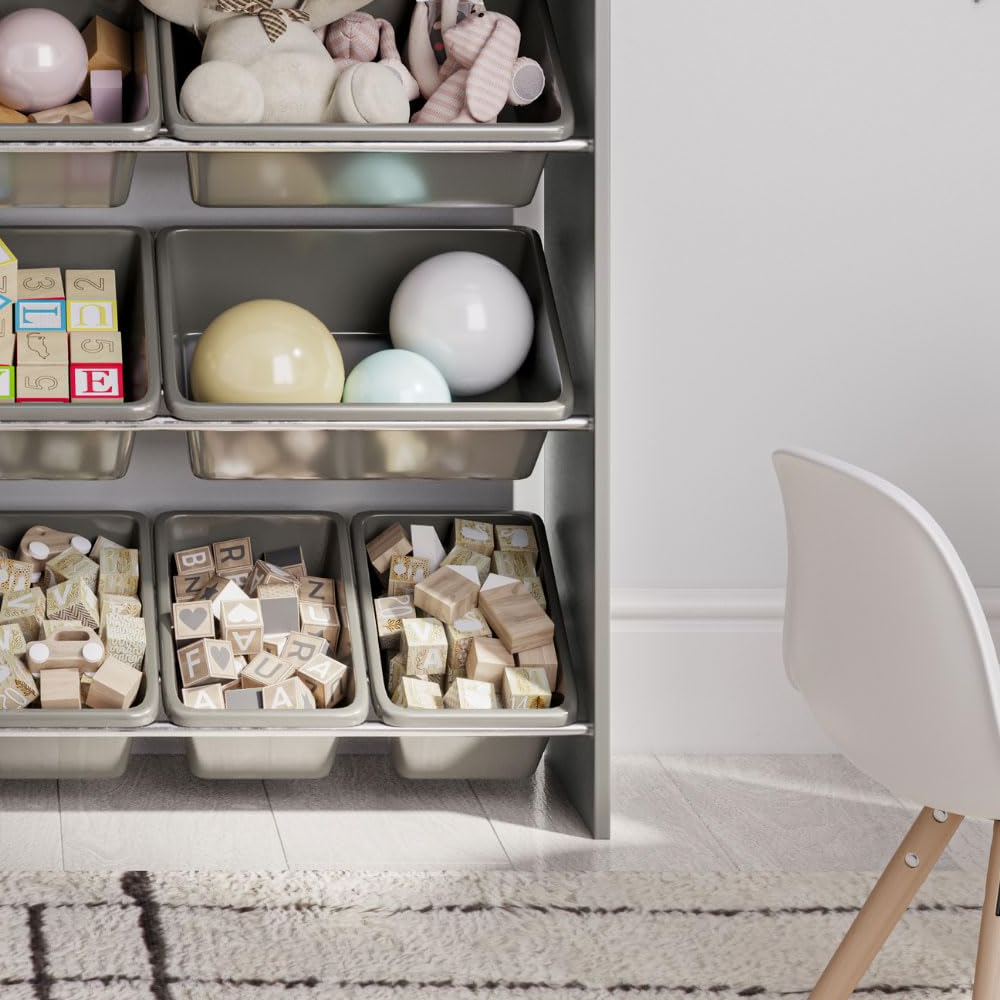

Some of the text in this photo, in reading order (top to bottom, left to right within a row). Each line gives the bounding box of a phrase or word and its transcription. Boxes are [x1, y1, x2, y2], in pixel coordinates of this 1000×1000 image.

[74, 277, 105, 291] 2
[25, 375, 58, 391] 5
[81, 370, 114, 393] E
[182, 551, 206, 567] B
[219, 544, 245, 563] R
[231, 631, 256, 651] A
[289, 639, 316, 662] R
[184, 647, 201, 678] F
[253, 657, 283, 680] U
[271, 686, 297, 709] A
